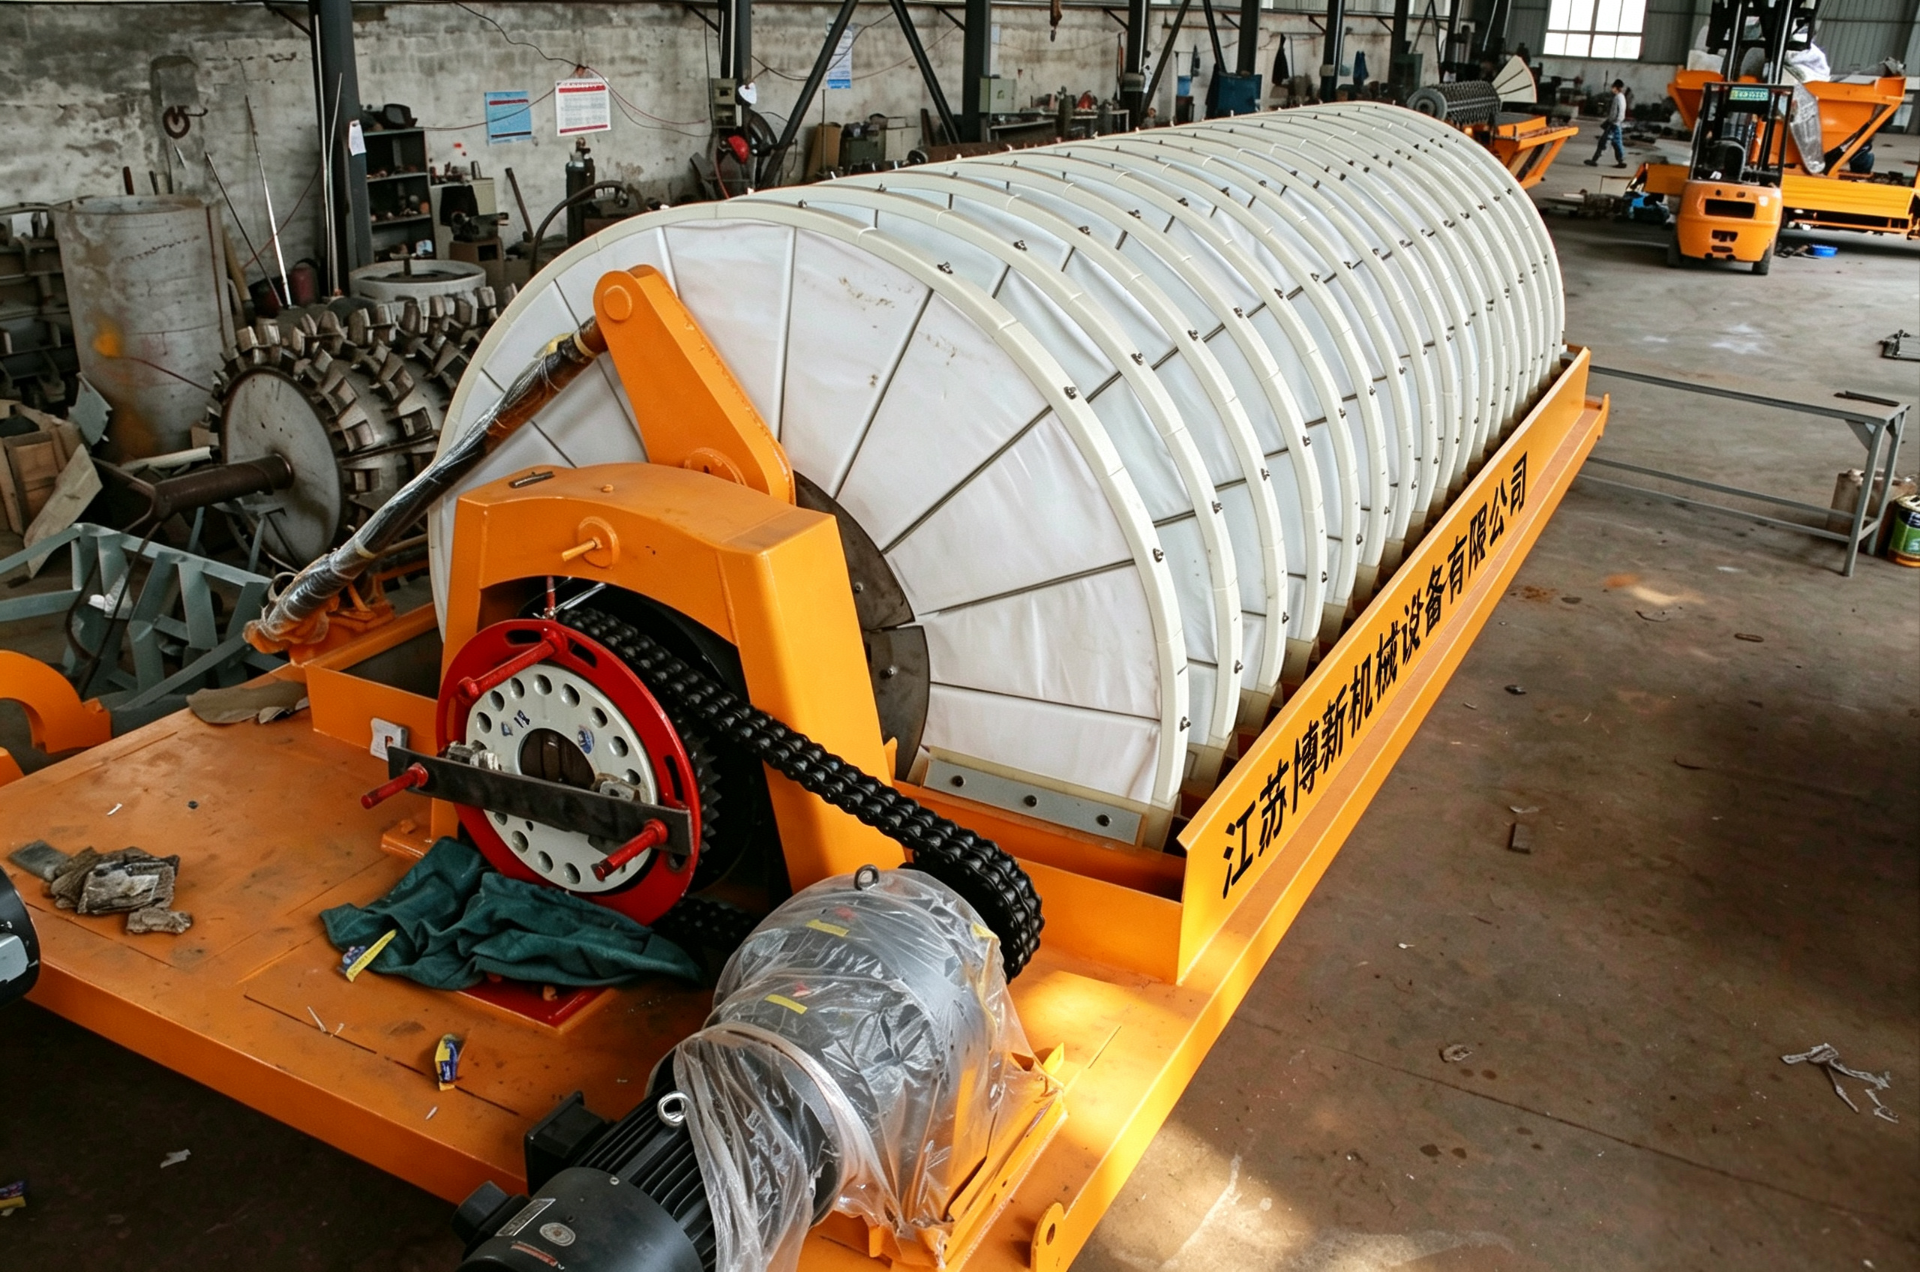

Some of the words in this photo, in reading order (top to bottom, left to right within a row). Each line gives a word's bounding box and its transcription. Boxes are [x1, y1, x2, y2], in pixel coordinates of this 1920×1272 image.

[1222, 450, 1528, 900] 江苏博新机械设备有限公司
